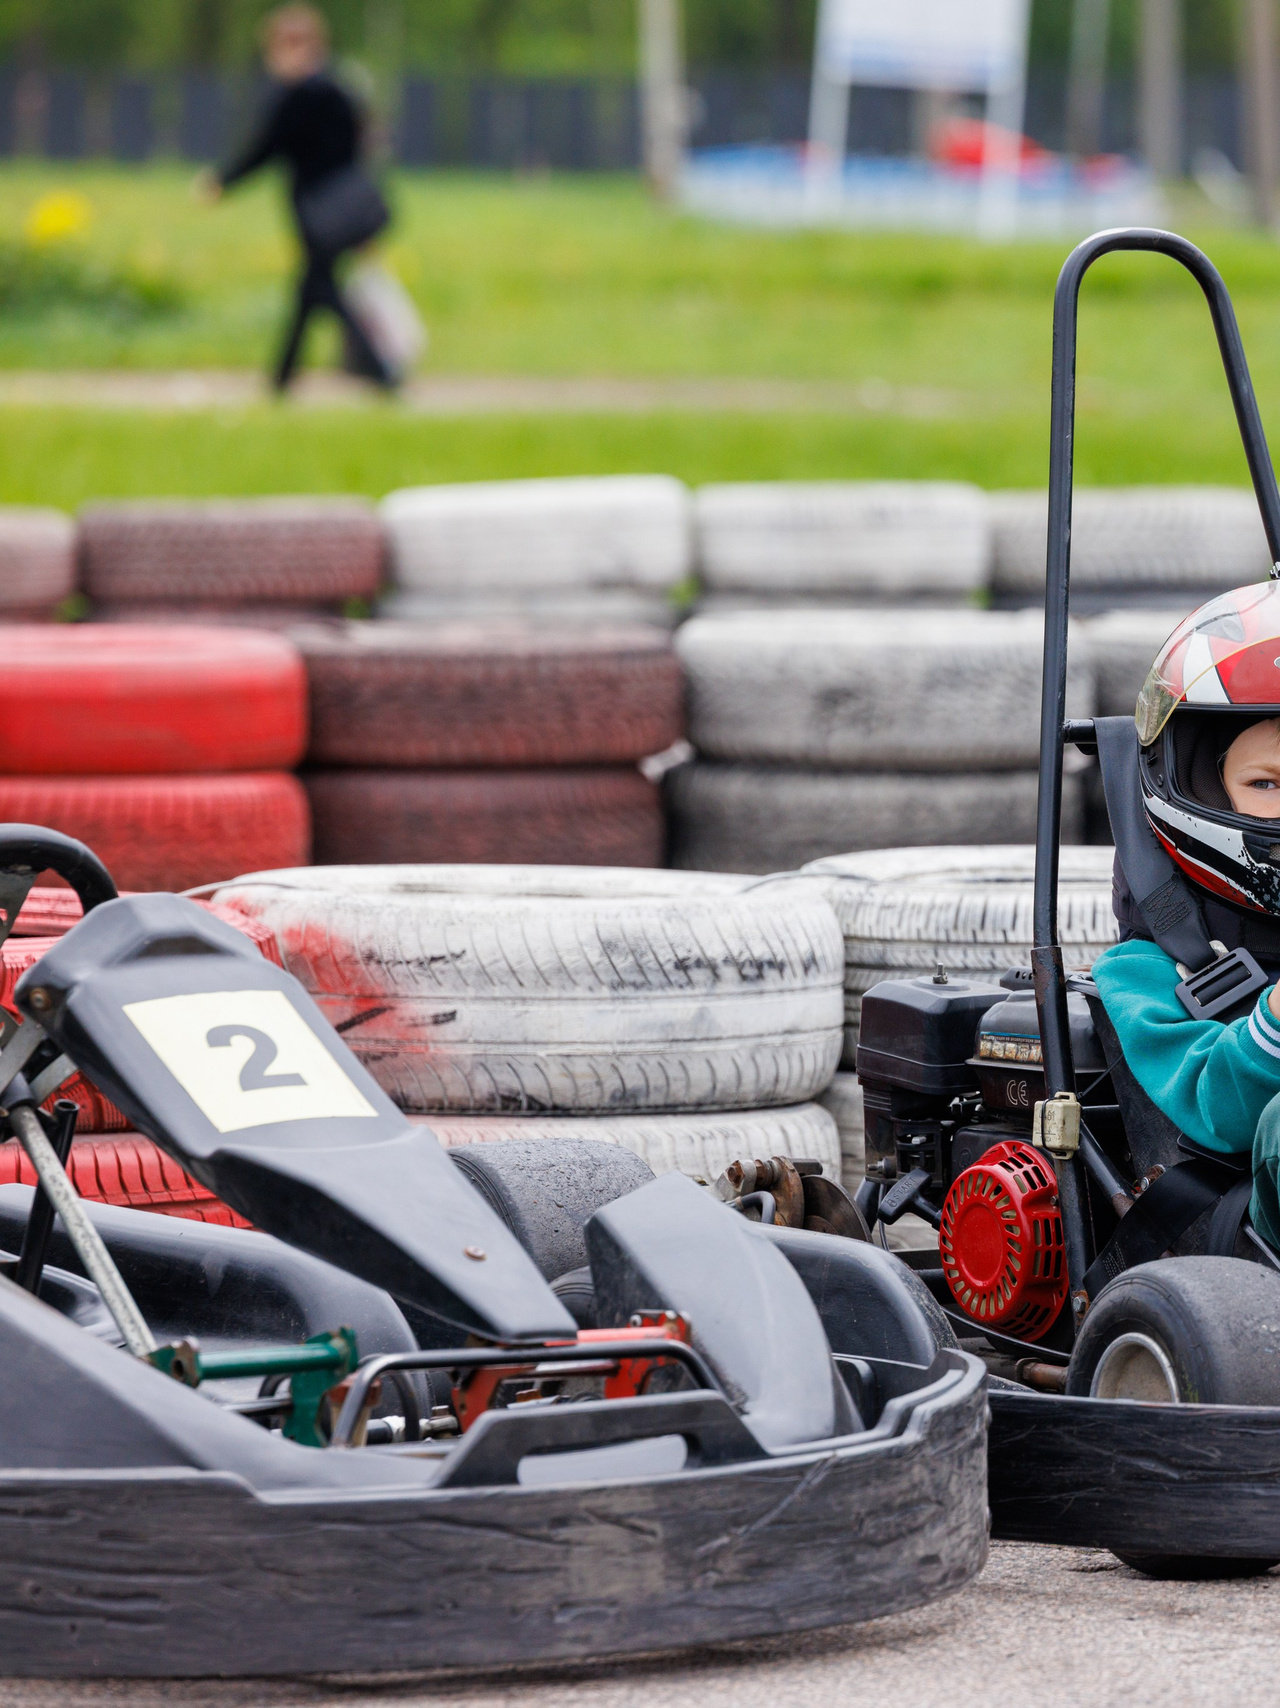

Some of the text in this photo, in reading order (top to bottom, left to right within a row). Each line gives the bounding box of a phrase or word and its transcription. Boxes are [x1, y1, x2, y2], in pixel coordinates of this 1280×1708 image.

[205, 1023, 309, 1092] 2
[1006, 1079, 1029, 1107] CE
[893, 1177, 916, 1200] START
